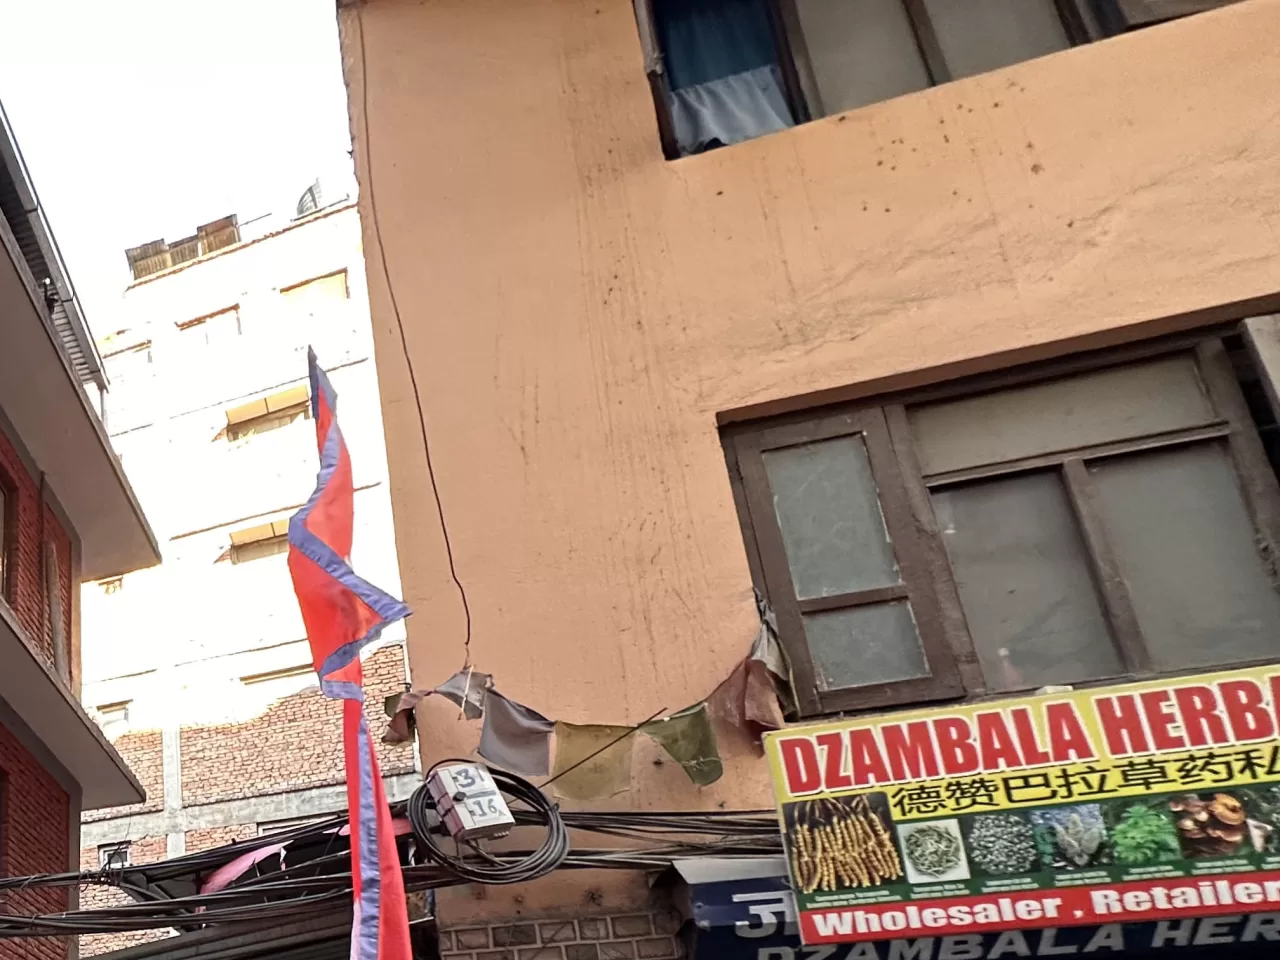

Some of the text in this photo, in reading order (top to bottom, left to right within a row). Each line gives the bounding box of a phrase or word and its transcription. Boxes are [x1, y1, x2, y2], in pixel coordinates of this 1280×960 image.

[779, 676, 1280, 794] DZAMBALA HERB
[812, 897, 1062, 937] Wholesaler
